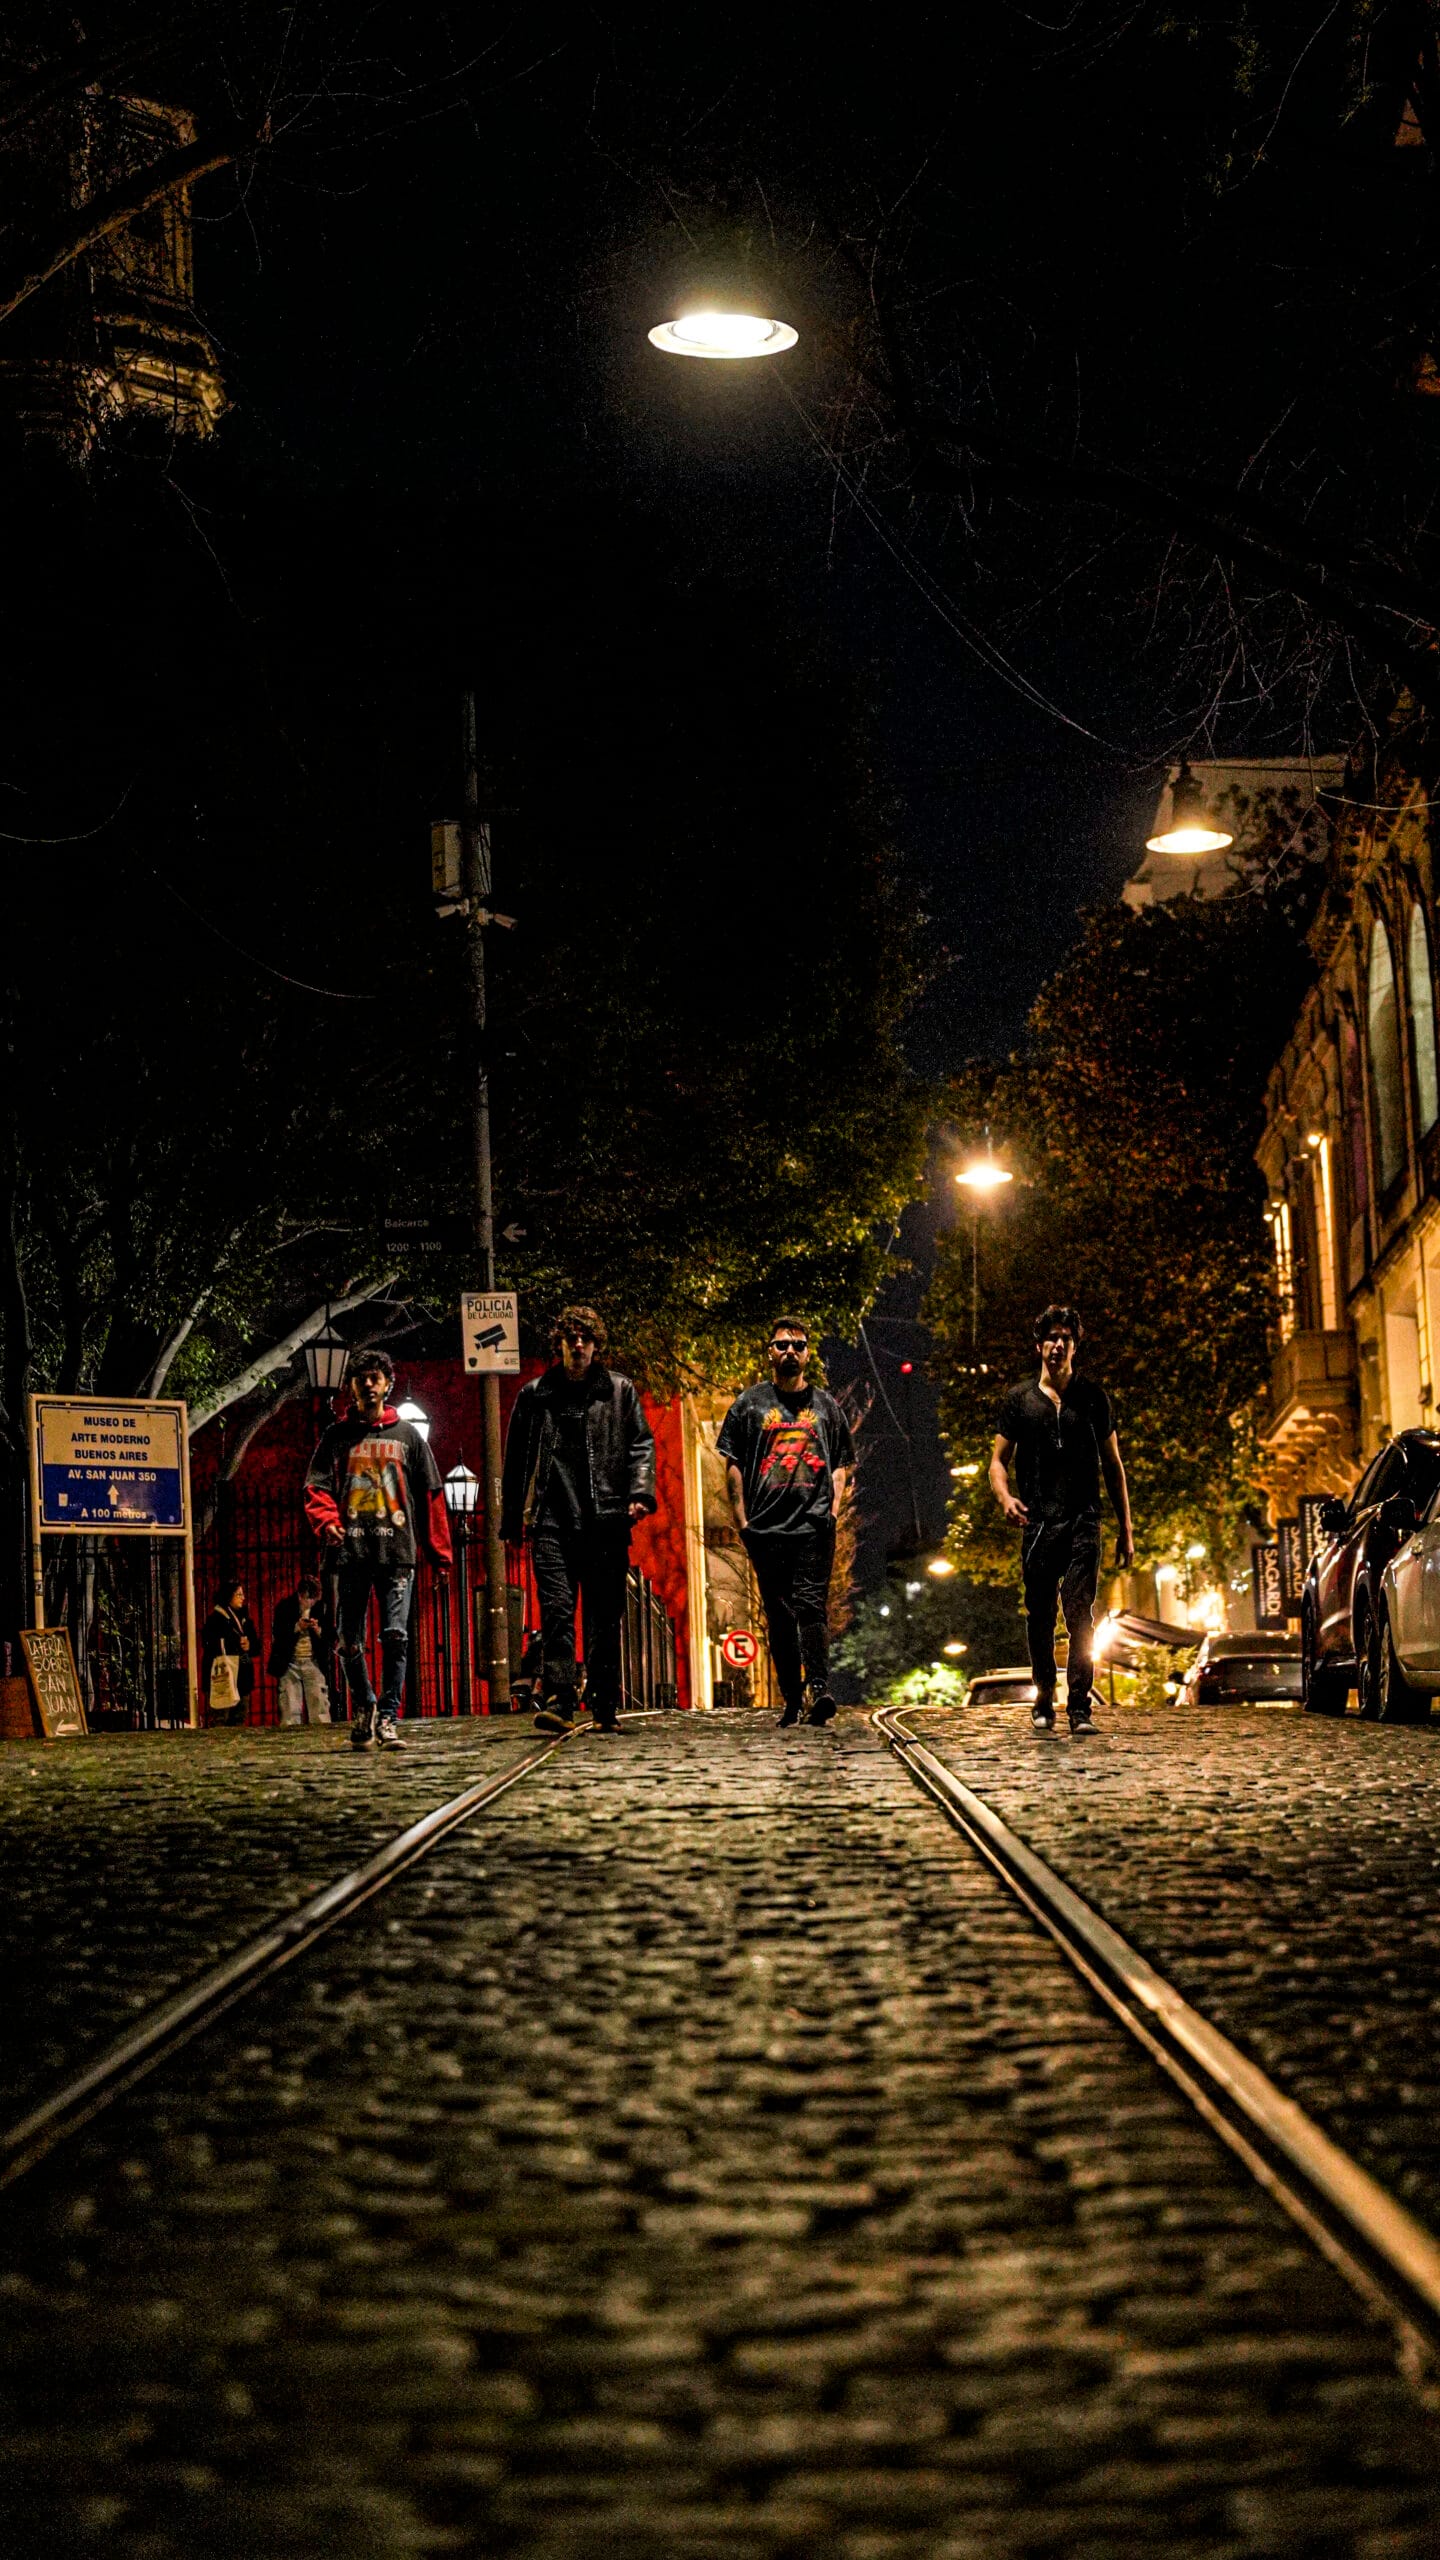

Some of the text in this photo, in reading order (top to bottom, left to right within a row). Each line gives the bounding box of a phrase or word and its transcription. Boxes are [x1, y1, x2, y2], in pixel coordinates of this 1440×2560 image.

[386, 1241, 410, 1252] 1200
[419, 1240, 443, 1252] 1100
[467, 1300, 512, 1311] POLICIA
[468, 1311, 513, 1319] DE LA CIUDAD
[84, 1416, 136, 1427] MUSEO DE
[71, 1433, 150, 1445] ARTE MODERNO
[75, 1450, 148, 1461] BUENOS AIRES
[68, 1469, 157, 1482] AV. SAN JUAN 350
[81, 1508, 147, 1519] A 100 metros
[1290, 1526, 1302, 1599] SAGARDI
[1264, 1548, 1281, 1616] SAGARDI
[32, 1656, 69, 1673] SOBRE
[36, 1673, 67, 1693] SAN
[46, 1694, 78, 1713] JUAN
